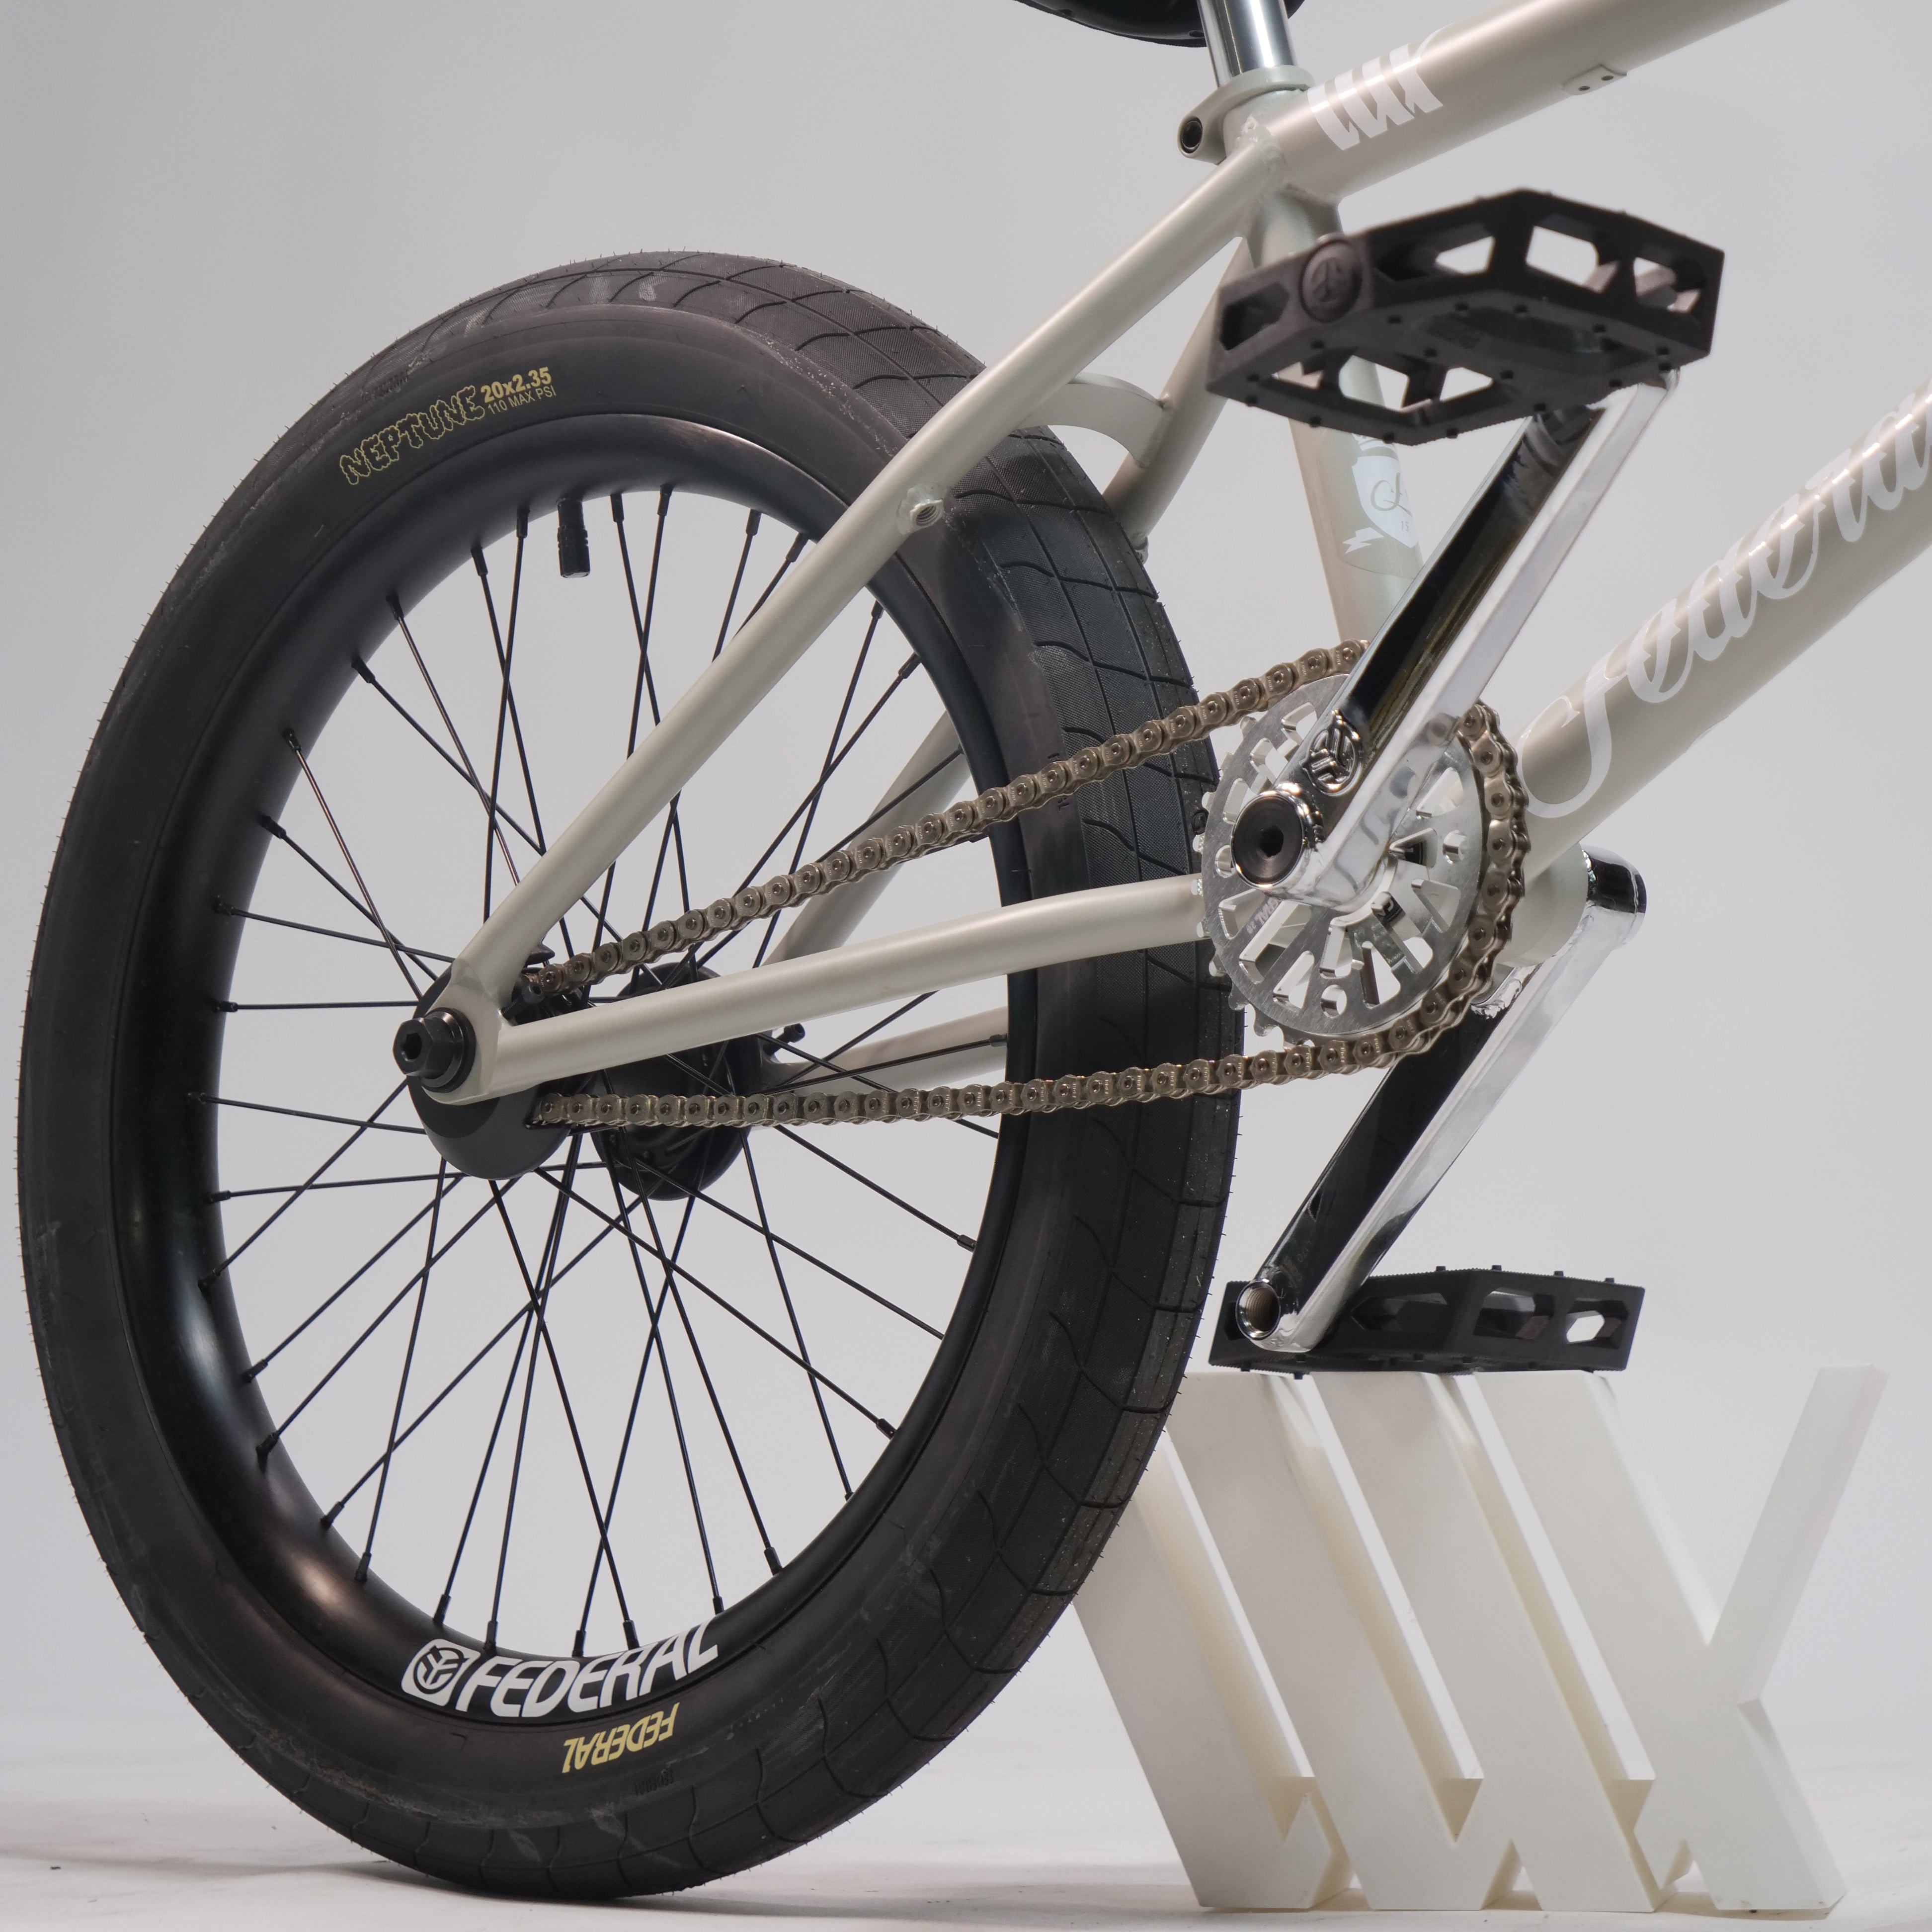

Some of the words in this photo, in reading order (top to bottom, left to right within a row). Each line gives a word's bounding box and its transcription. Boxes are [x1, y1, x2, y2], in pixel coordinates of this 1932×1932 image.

[481, 367, 552, 403] 20x2.35
[487, 402, 507, 415] 110
[510, 391, 536, 408] MAX
[536, 385, 557, 401] PSI
[340, 385, 485, 485] NEPTUNE
[455, 1615, 719, 1717] FEDERAL
[561, 1702, 680, 1774] FEDERAL
